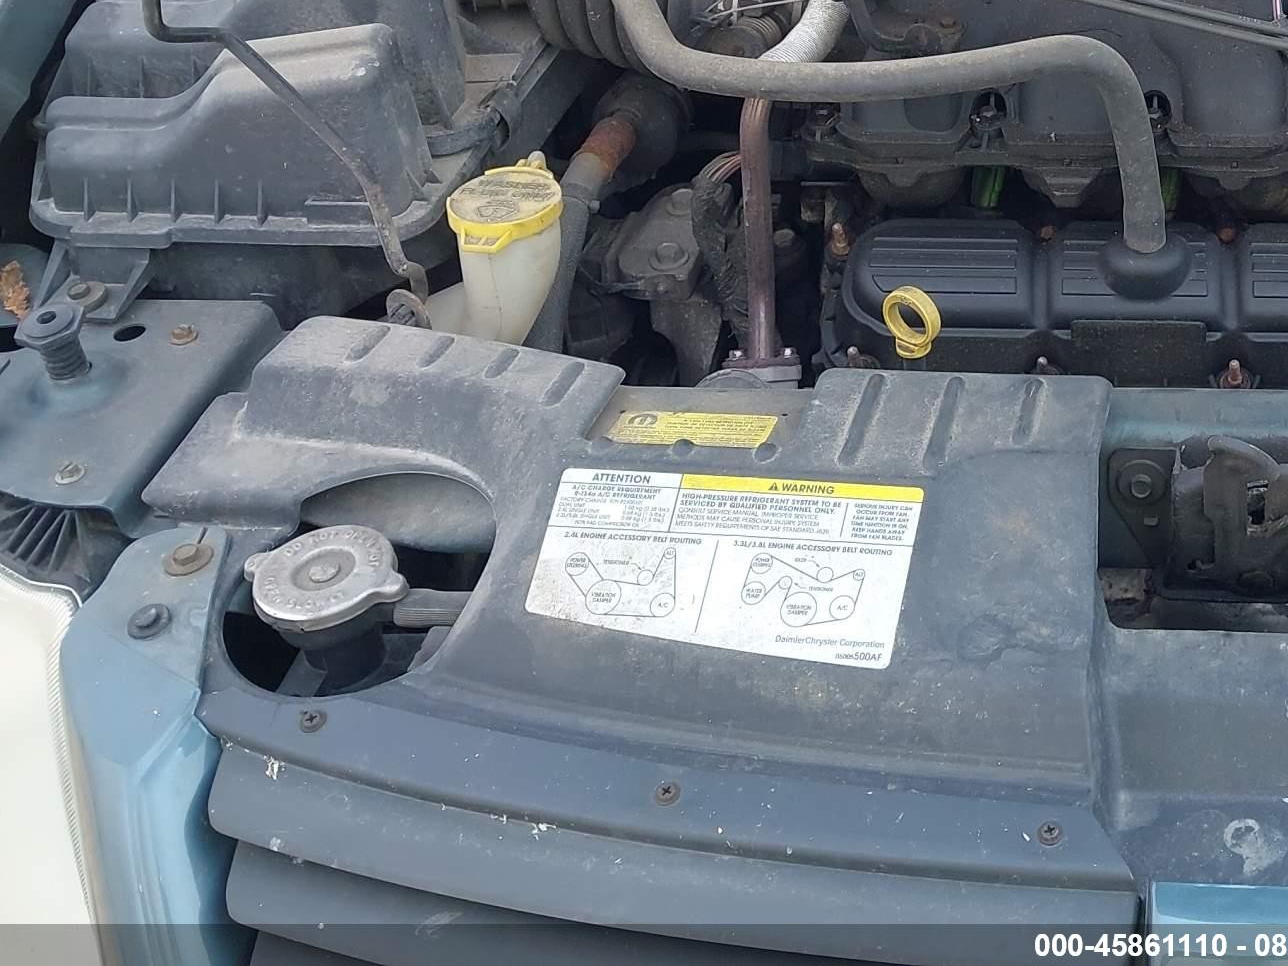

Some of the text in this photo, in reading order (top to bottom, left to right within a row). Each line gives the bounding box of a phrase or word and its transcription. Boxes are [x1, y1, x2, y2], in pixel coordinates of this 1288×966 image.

[591, 472, 651, 484] ATTENTION
[781, 483, 835, 494] WARNING
[681, 493, 738, 501] HIGH-PRESSURE
[739, 496, 789, 504] REFRIGERANT
[680, 499, 716, 507] SERVICED
[729, 502, 767, 510] QUALIFIED
[769, 505, 811, 513] PERSONNEL
[607, 534, 650, 542] ACCESSORY
[668, 537, 701, 545] ROUTING
[767, 541, 795, 549] ENGINE
[795, 543, 840, 552] ACCESSORY
[859, 547, 892, 556] ROUTING
[774, 634, 885, 649] DaimlerChrysler Corporation
